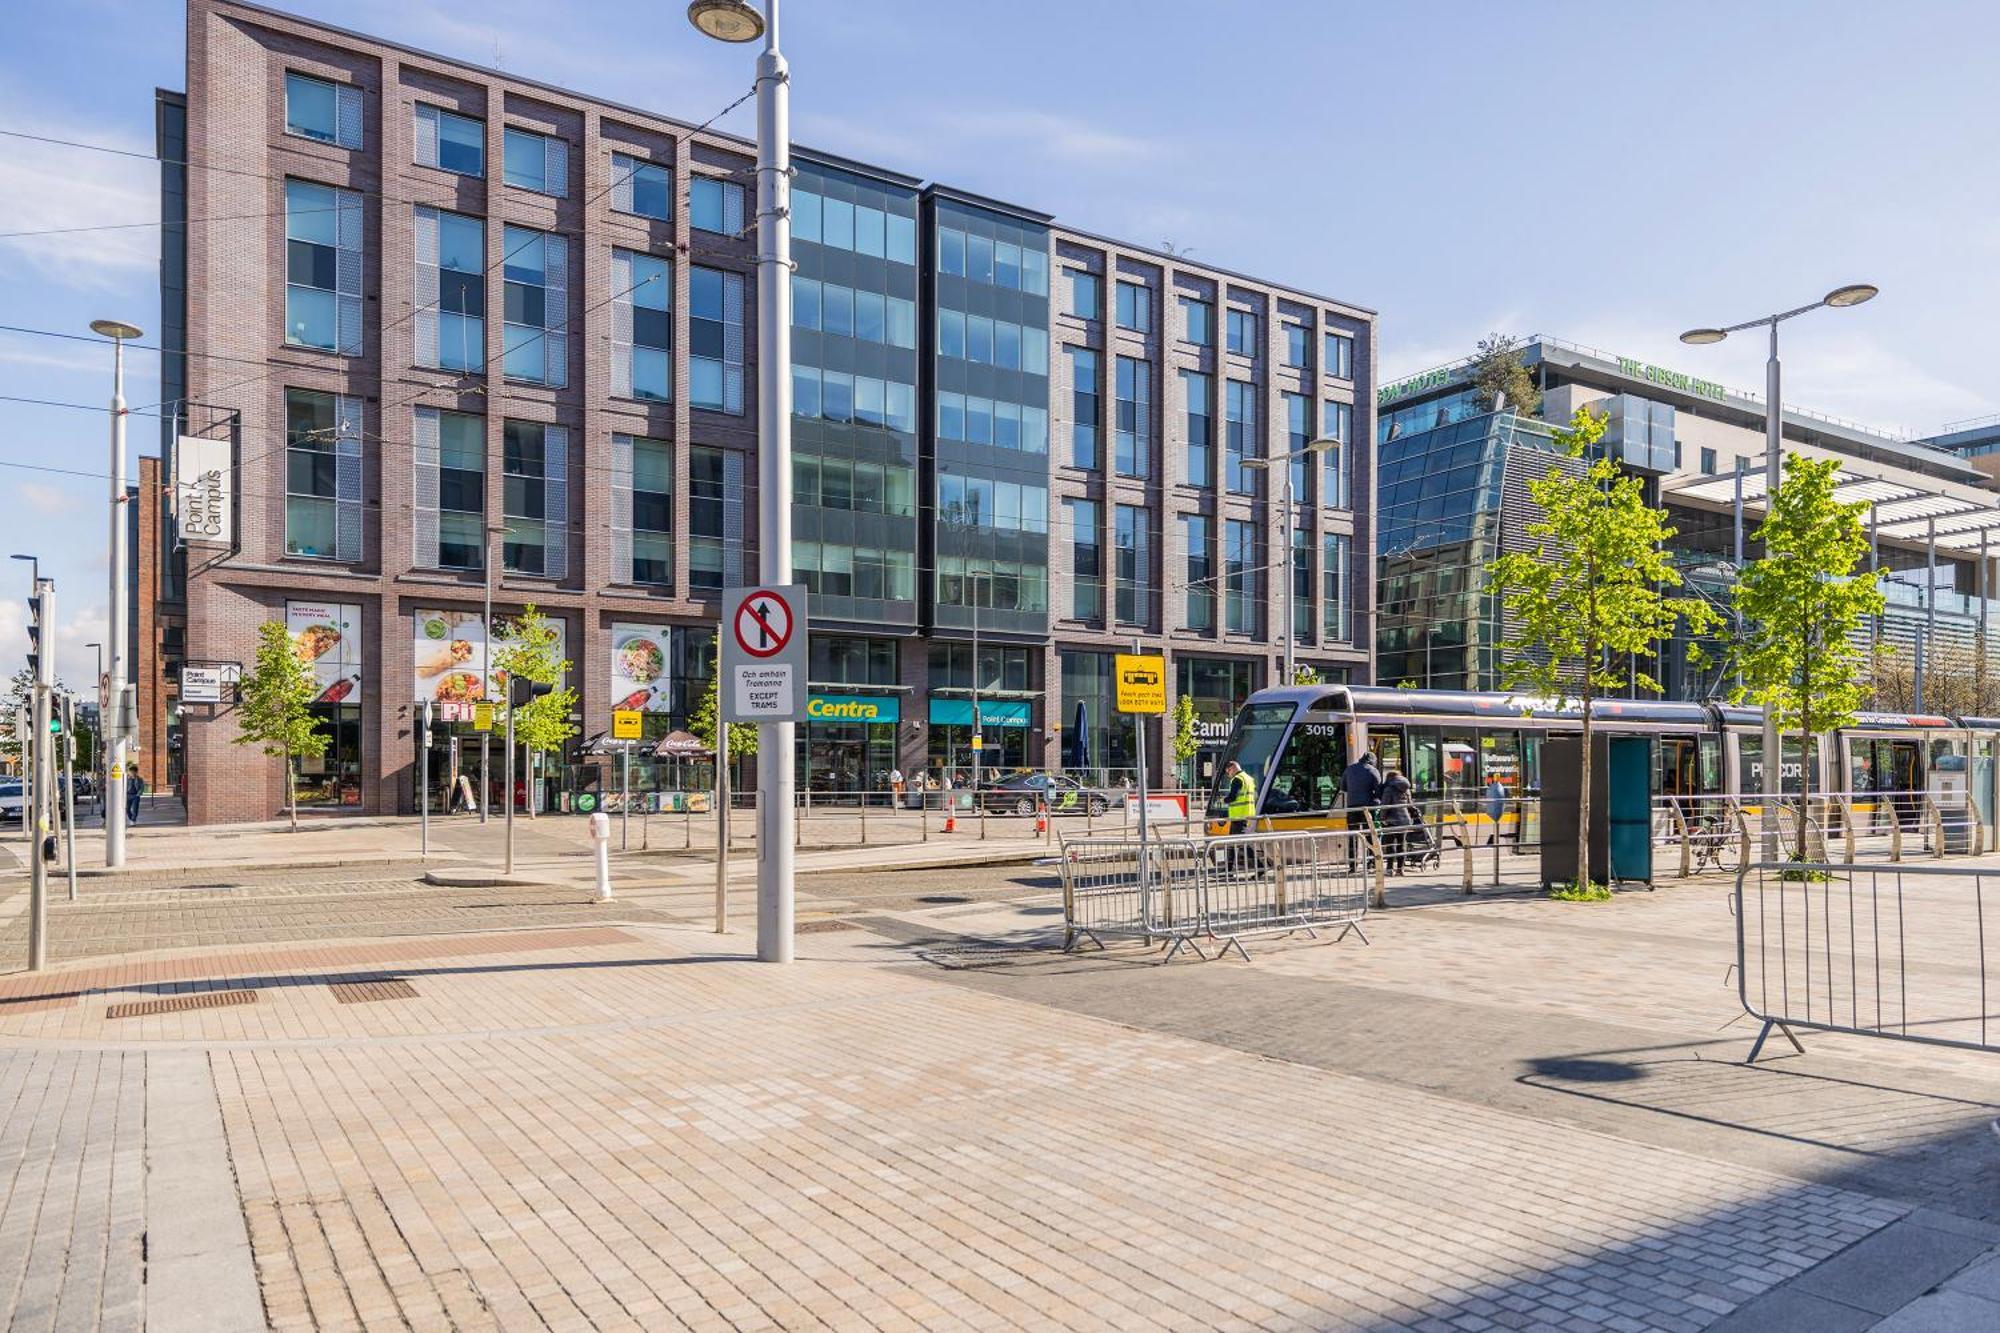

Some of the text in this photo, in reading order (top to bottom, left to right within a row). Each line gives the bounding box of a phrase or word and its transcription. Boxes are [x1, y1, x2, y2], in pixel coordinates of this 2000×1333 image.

[1407, 367, 1452, 392] HOTEL
[1616, 356, 1728, 402] THE GIBSON HOTEL
[203, 470, 225, 536] Campus
[185, 493, 203, 535] Point
[750, 692, 778, 700] EXCEPT
[751, 701, 778, 709] TRAMS
[807, 698, 879, 718] Centra
[1190, 718, 1234, 737] Camil
[1305, 724, 1335, 736] 3019
